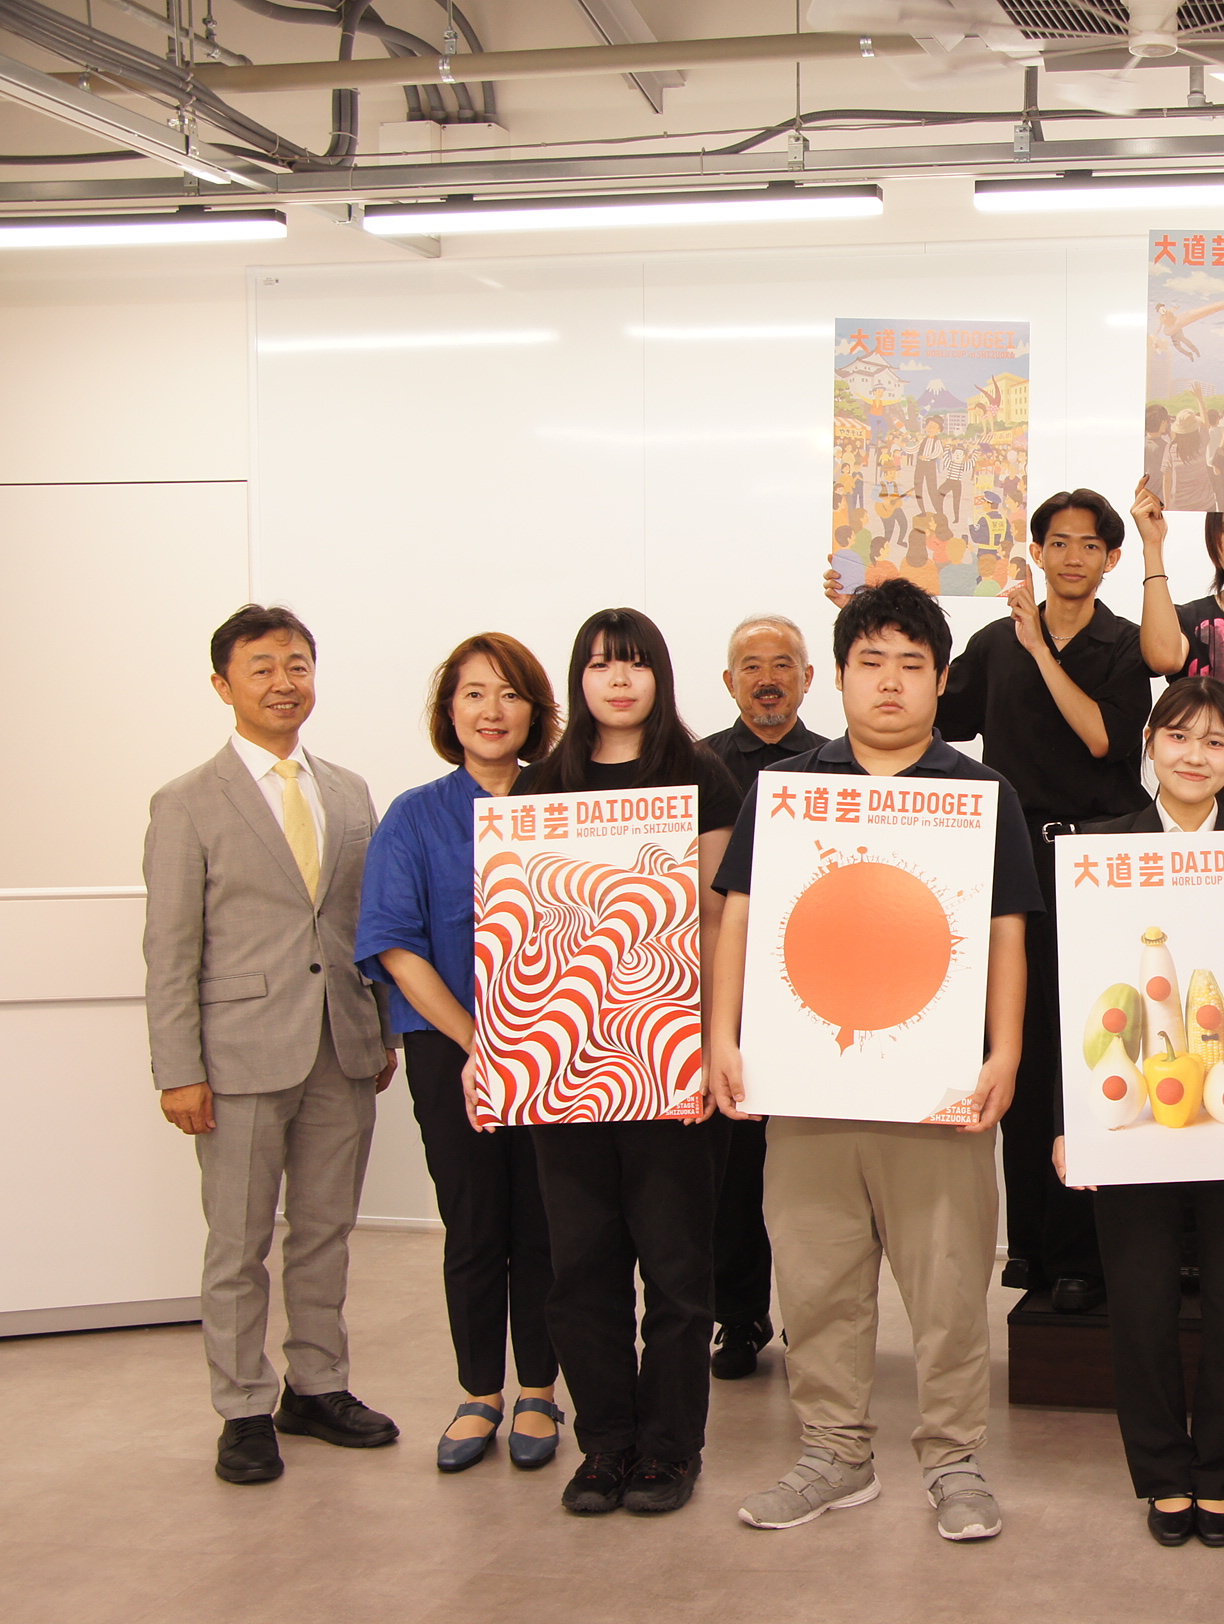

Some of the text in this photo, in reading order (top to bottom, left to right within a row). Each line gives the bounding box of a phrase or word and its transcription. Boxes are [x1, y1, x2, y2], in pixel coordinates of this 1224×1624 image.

[850, 328, 921, 357] 大道芸
[926, 330, 1016, 349] DAIDOGEI
[926, 350, 950, 358] WORLD
[576, 795, 693, 824] DAIDOGEI
[771, 786, 861, 823] 大道芸
[868, 790, 982, 816] DAIDOGEI
[479, 803, 568, 842] 大道芸
[576, 822, 693, 838] WORLD CUP in SHIZUOKA
[868, 815, 981, 829] WORLD CUP in SHIZUOKA
[1074, 852, 1164, 888] 大道芸
[1172, 875, 1202, 886] WORLD
[1205, 875, 1222, 885] CUP
[930, 1114, 971, 1123] SHIZUOKA
